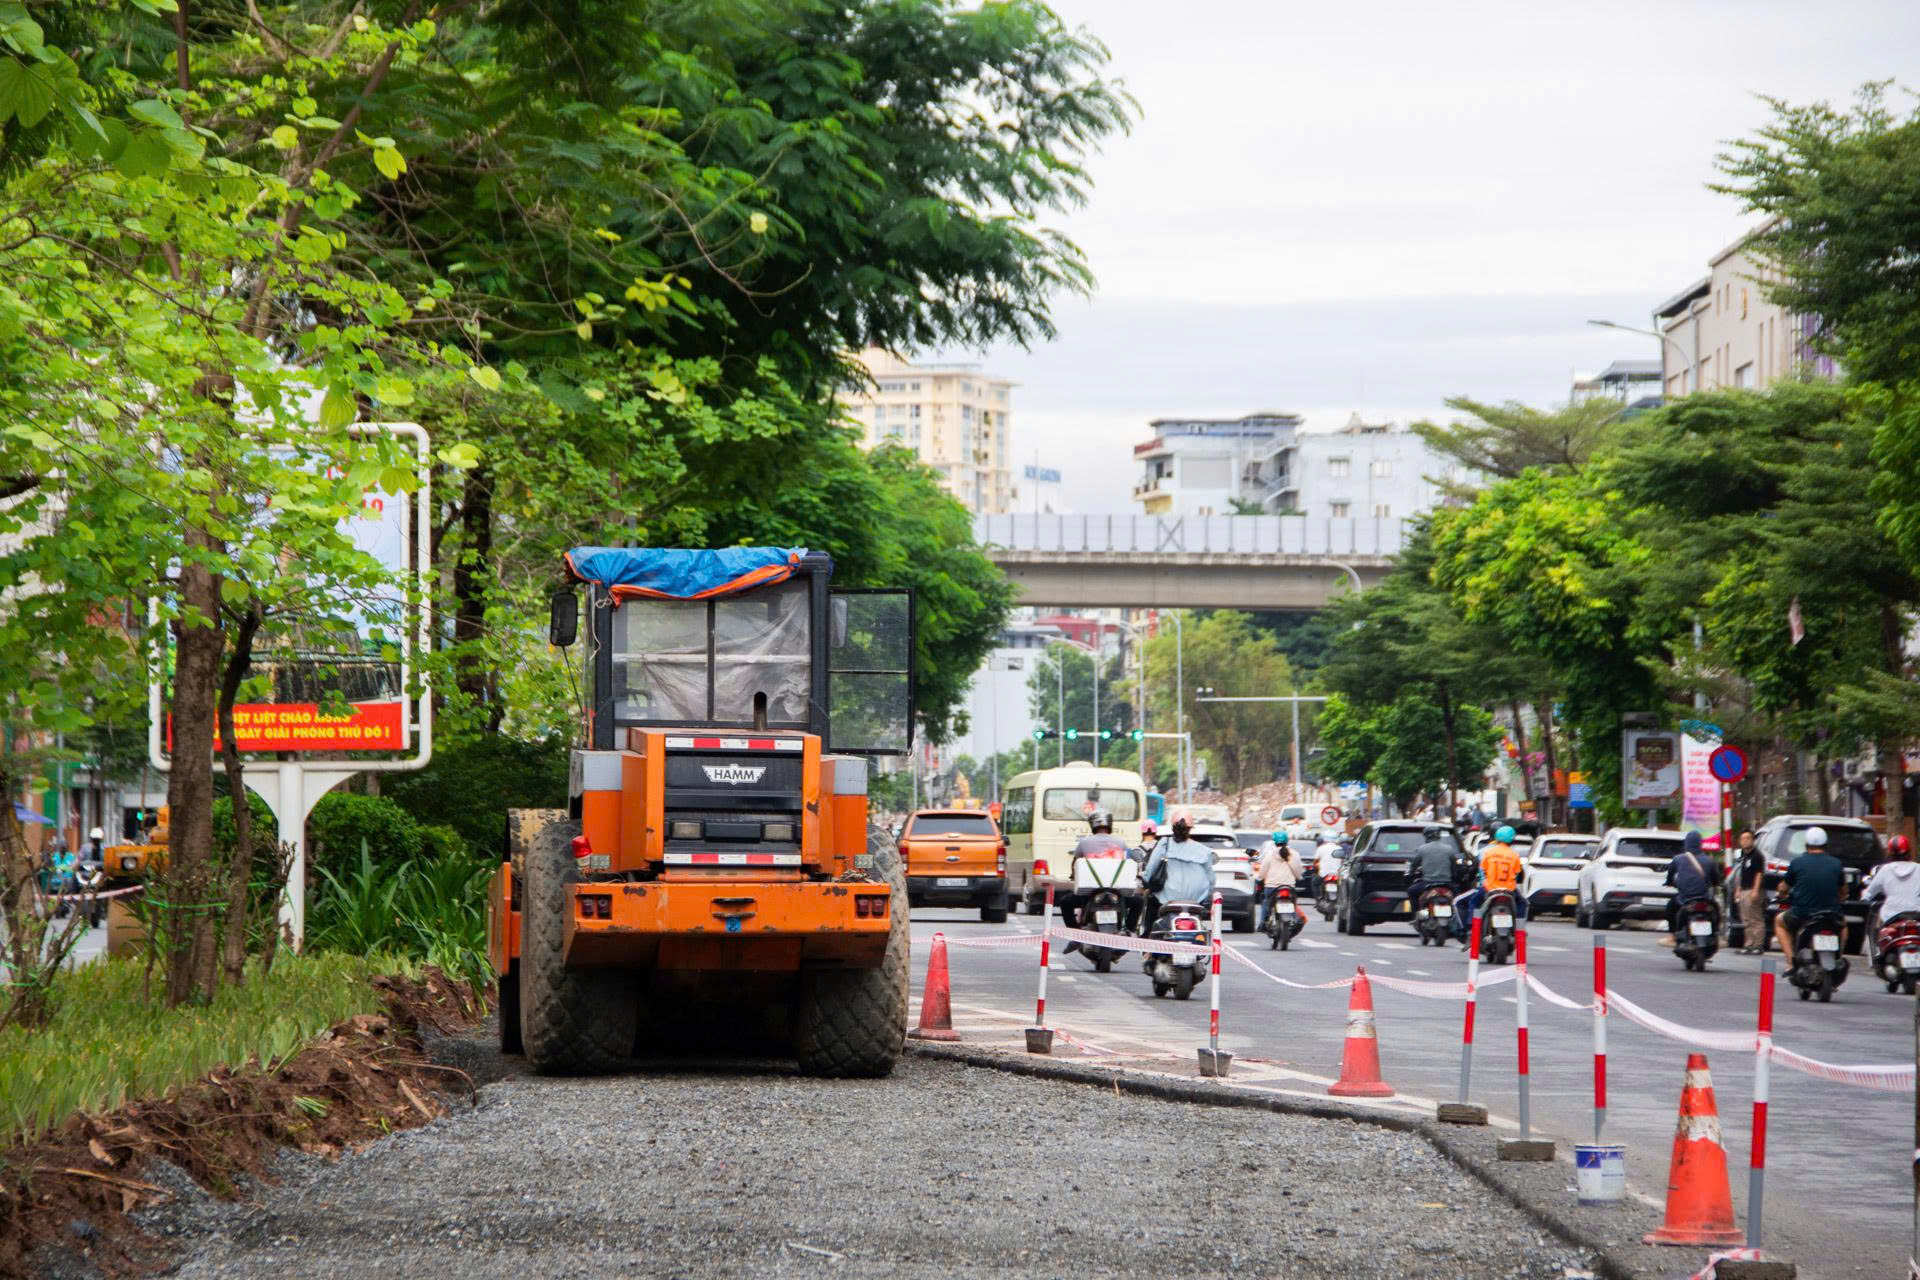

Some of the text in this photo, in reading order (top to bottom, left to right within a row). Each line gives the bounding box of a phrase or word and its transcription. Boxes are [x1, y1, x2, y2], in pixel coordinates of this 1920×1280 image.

[253, 711, 276, 725] LIỆT
[714, 769, 755, 780] HAMM
[1059, 826, 1124, 834] HYUAI
[1493, 861, 1511, 882] 13
